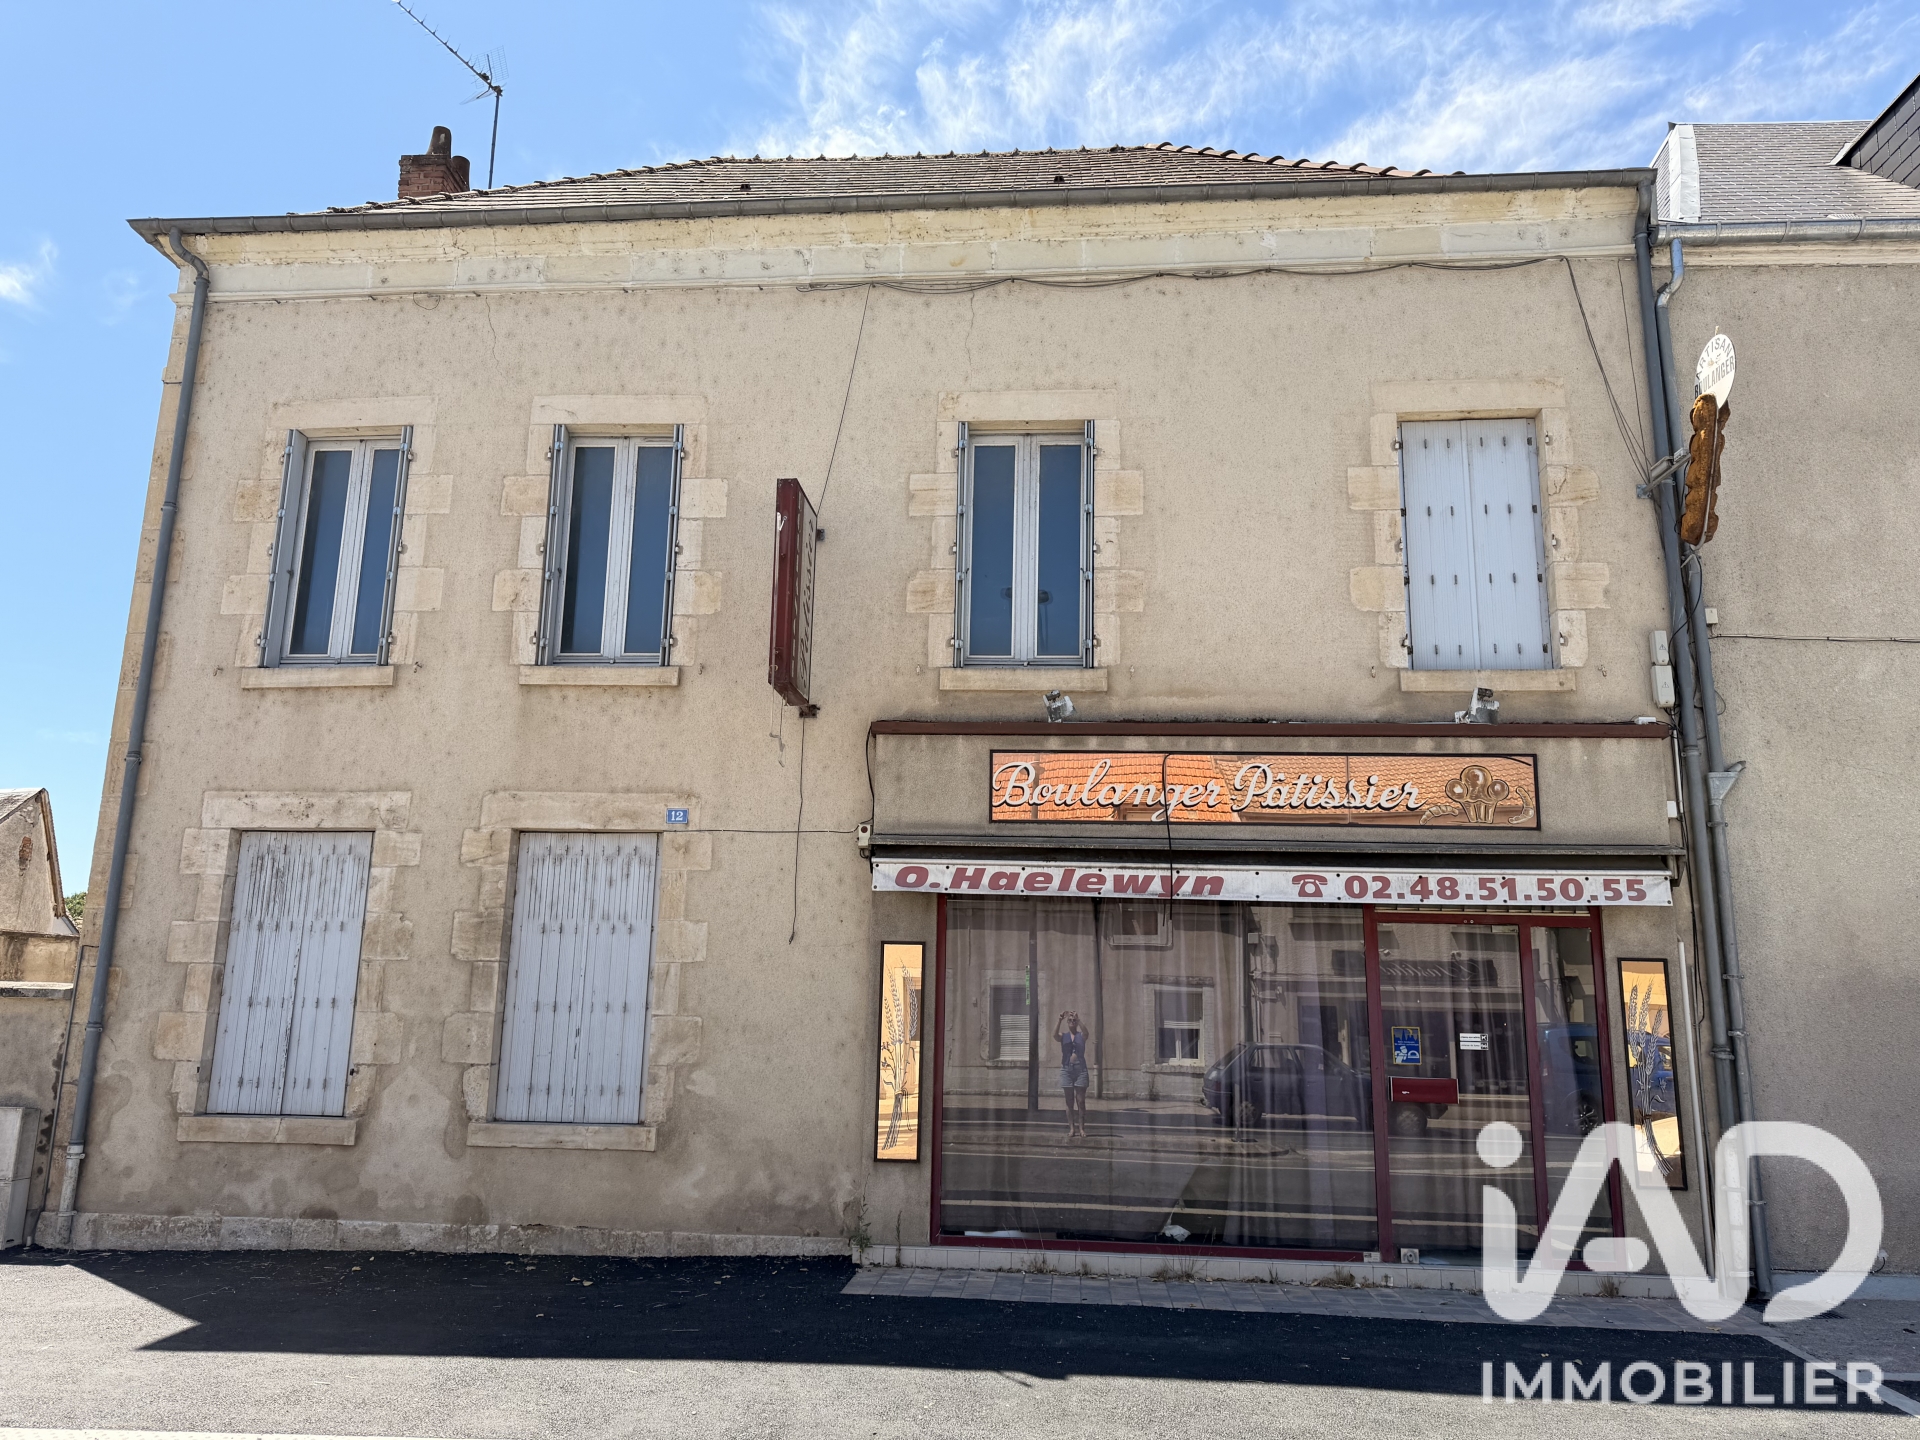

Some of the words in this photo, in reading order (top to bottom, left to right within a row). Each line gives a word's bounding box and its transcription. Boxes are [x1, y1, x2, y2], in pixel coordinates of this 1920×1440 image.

[1694, 355, 1735, 401] BOULANGER
[1696, 337, 1732, 380] ARTISAN
[992, 759, 1222, 822] Boulanger
[1231, 762, 1428, 812] Pâtissier
[671, 810, 684, 821] 12
[1344, 875, 1647, 901] 02.48.51.50.55
